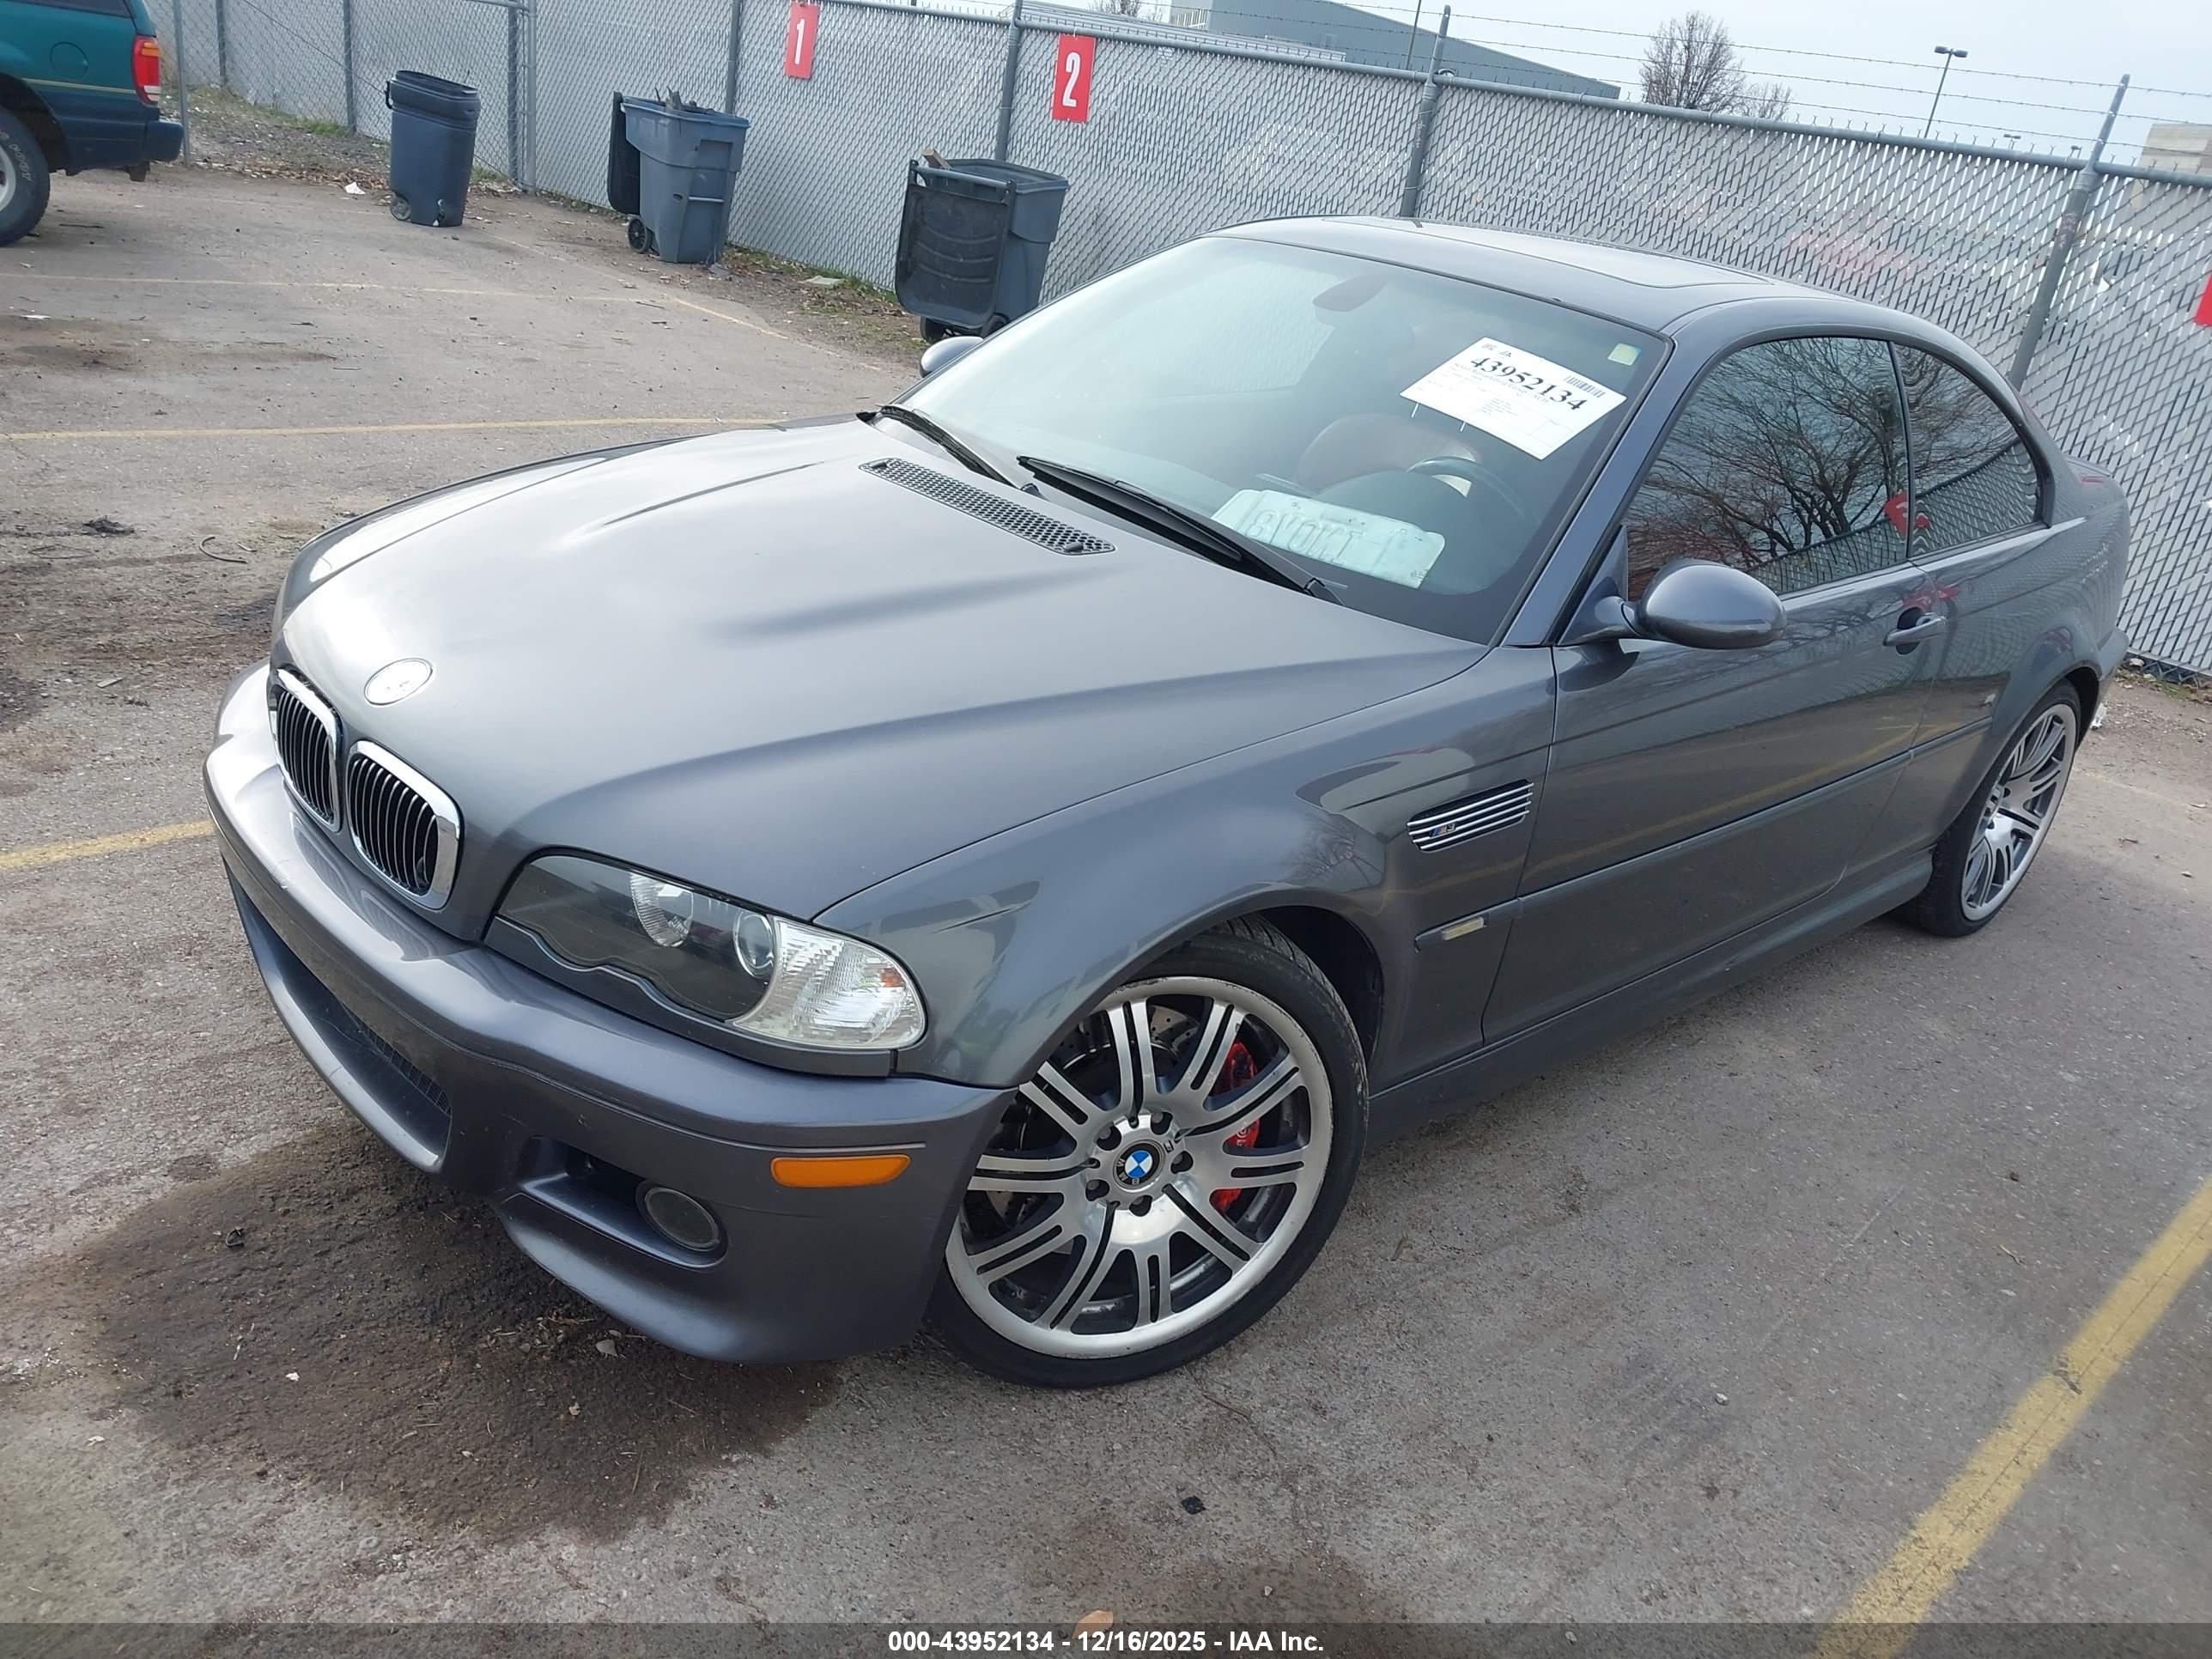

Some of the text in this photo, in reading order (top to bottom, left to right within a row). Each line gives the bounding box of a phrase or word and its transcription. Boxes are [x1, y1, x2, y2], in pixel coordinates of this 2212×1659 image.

[794, 19, 805, 65] 1
[1062, 52, 1081, 107] 2
[1470, 357, 1588, 410] 43952134
